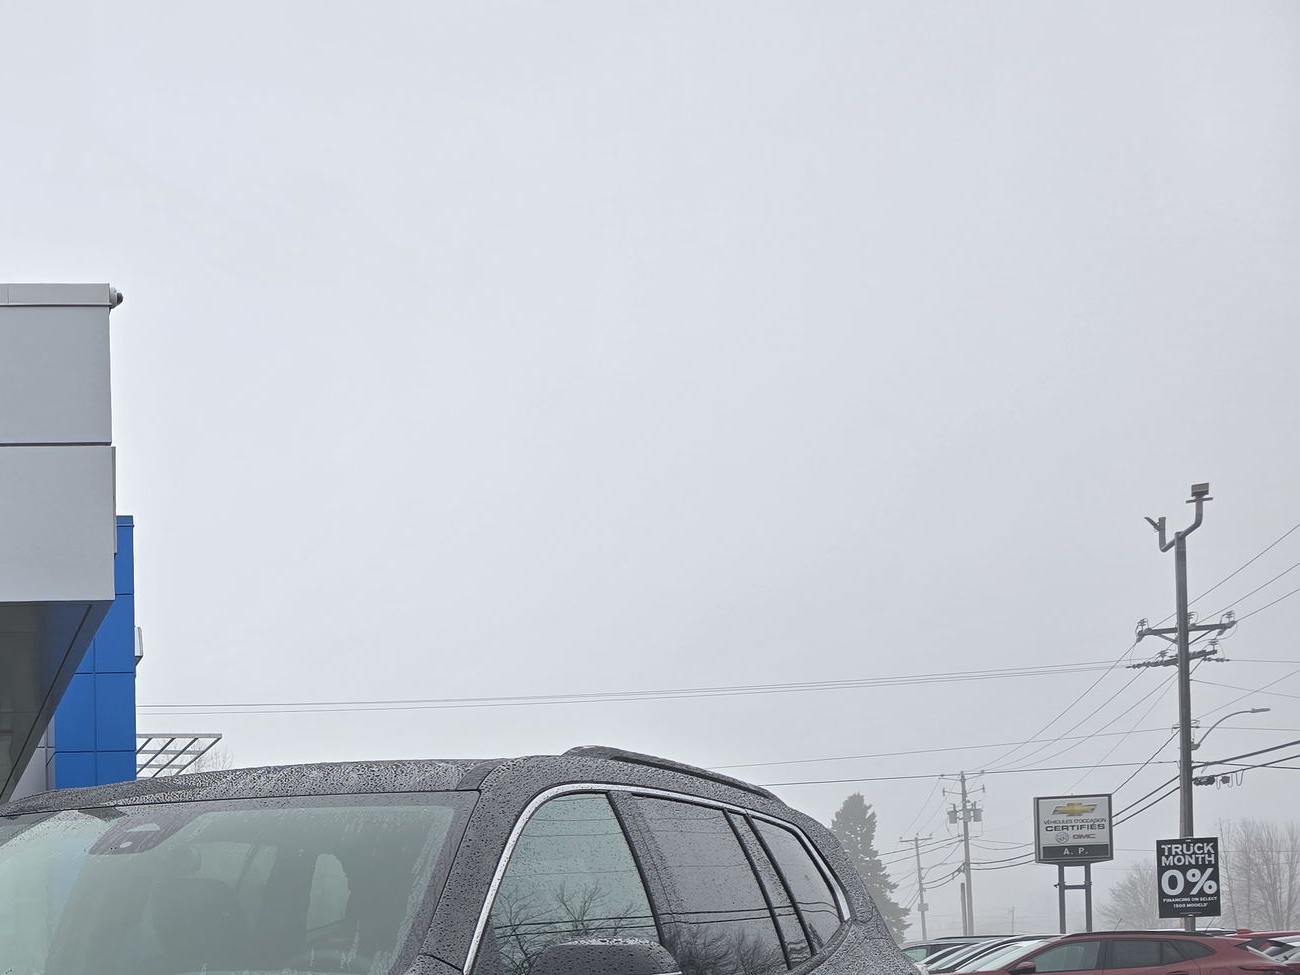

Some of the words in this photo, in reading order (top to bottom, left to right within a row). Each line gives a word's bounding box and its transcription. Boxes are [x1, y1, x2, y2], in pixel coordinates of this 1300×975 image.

[1045, 822, 1106, 832] CERTIFIÉS
[1063, 847, 1074, 856] A.
[1078, 846, 1089, 855] P.
[1161, 842, 1215, 856] TRUCK
[1161, 854, 1215, 867] MONTH
[1161, 867, 1218, 896] 0%
